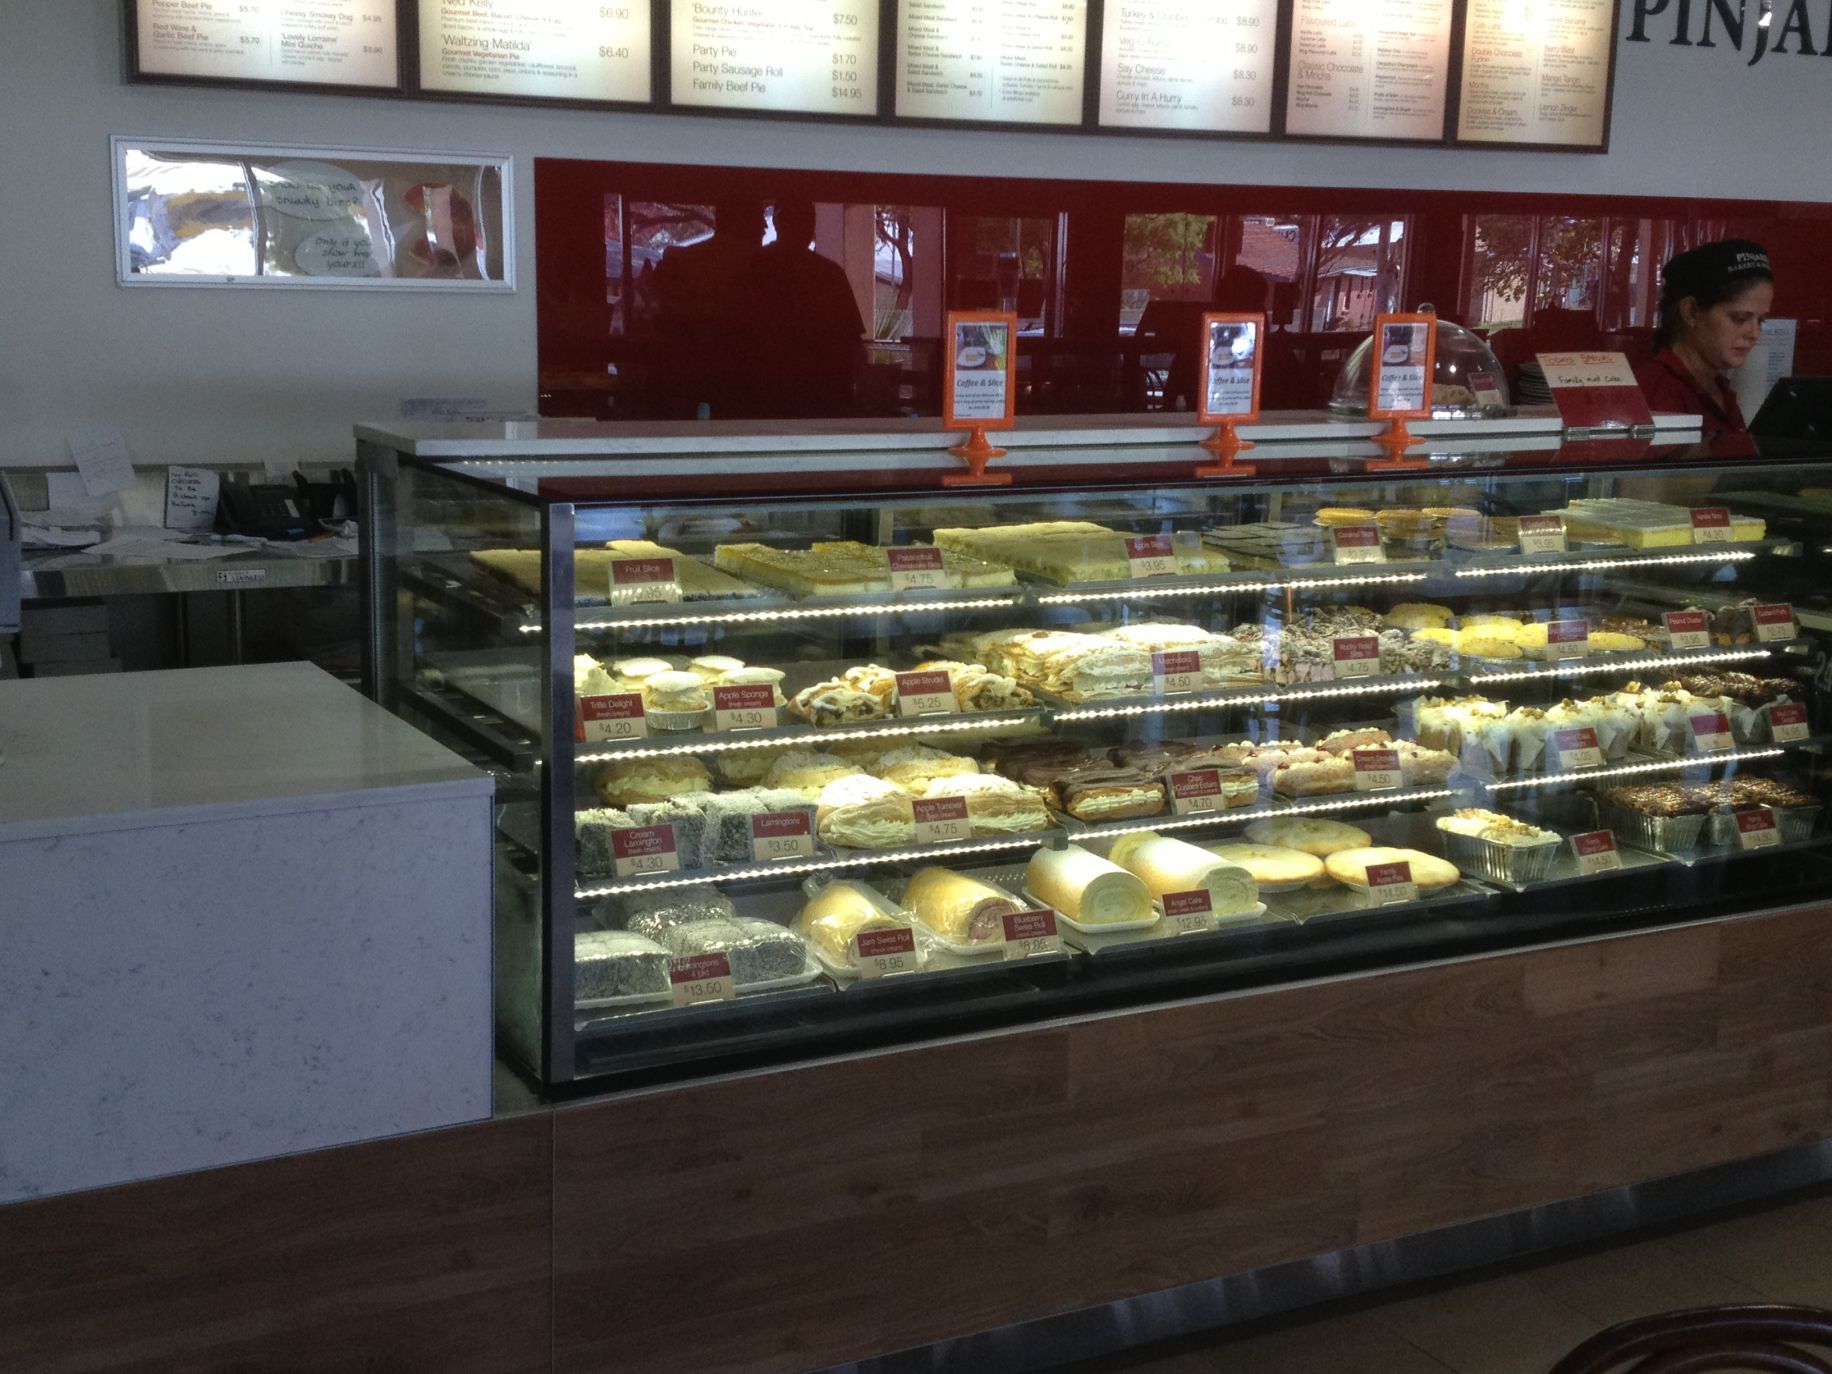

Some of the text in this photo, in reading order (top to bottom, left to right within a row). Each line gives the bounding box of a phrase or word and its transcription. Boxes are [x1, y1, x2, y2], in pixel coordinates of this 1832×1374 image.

[1626, 0, 1832, 66] PINJA
[598, 46, 629, 59] $6.40
[692, 44, 737, 58] Party Pie
[692, 61, 783, 78] Party Sausage Roll
[692, 78, 766, 93] Family Beef Pie
[1116, 90, 1140, 103] Curry
[1159, 93, 1184, 105] Hurry
[957, 379, 979, 389] Coffee
[901, 676, 944, 687] Apple Strudel
[719, 690, 769, 700] Apple Sponge
[608, 699, 633, 710] Delight
[730, 711, 762, 724] $4.30
[600, 722, 632, 735] $4.20
[916, 804, 934, 814] Apple
[760, 816, 801, 828] Lamingtons
[929, 822, 958, 835] $4.75
[629, 830, 655, 840] Cream
[624, 837, 663, 849] Lamington
[768, 839, 799, 852] $3.50
[861, 938, 876, 947] Jam
[897, 933, 910, 942] Roll
